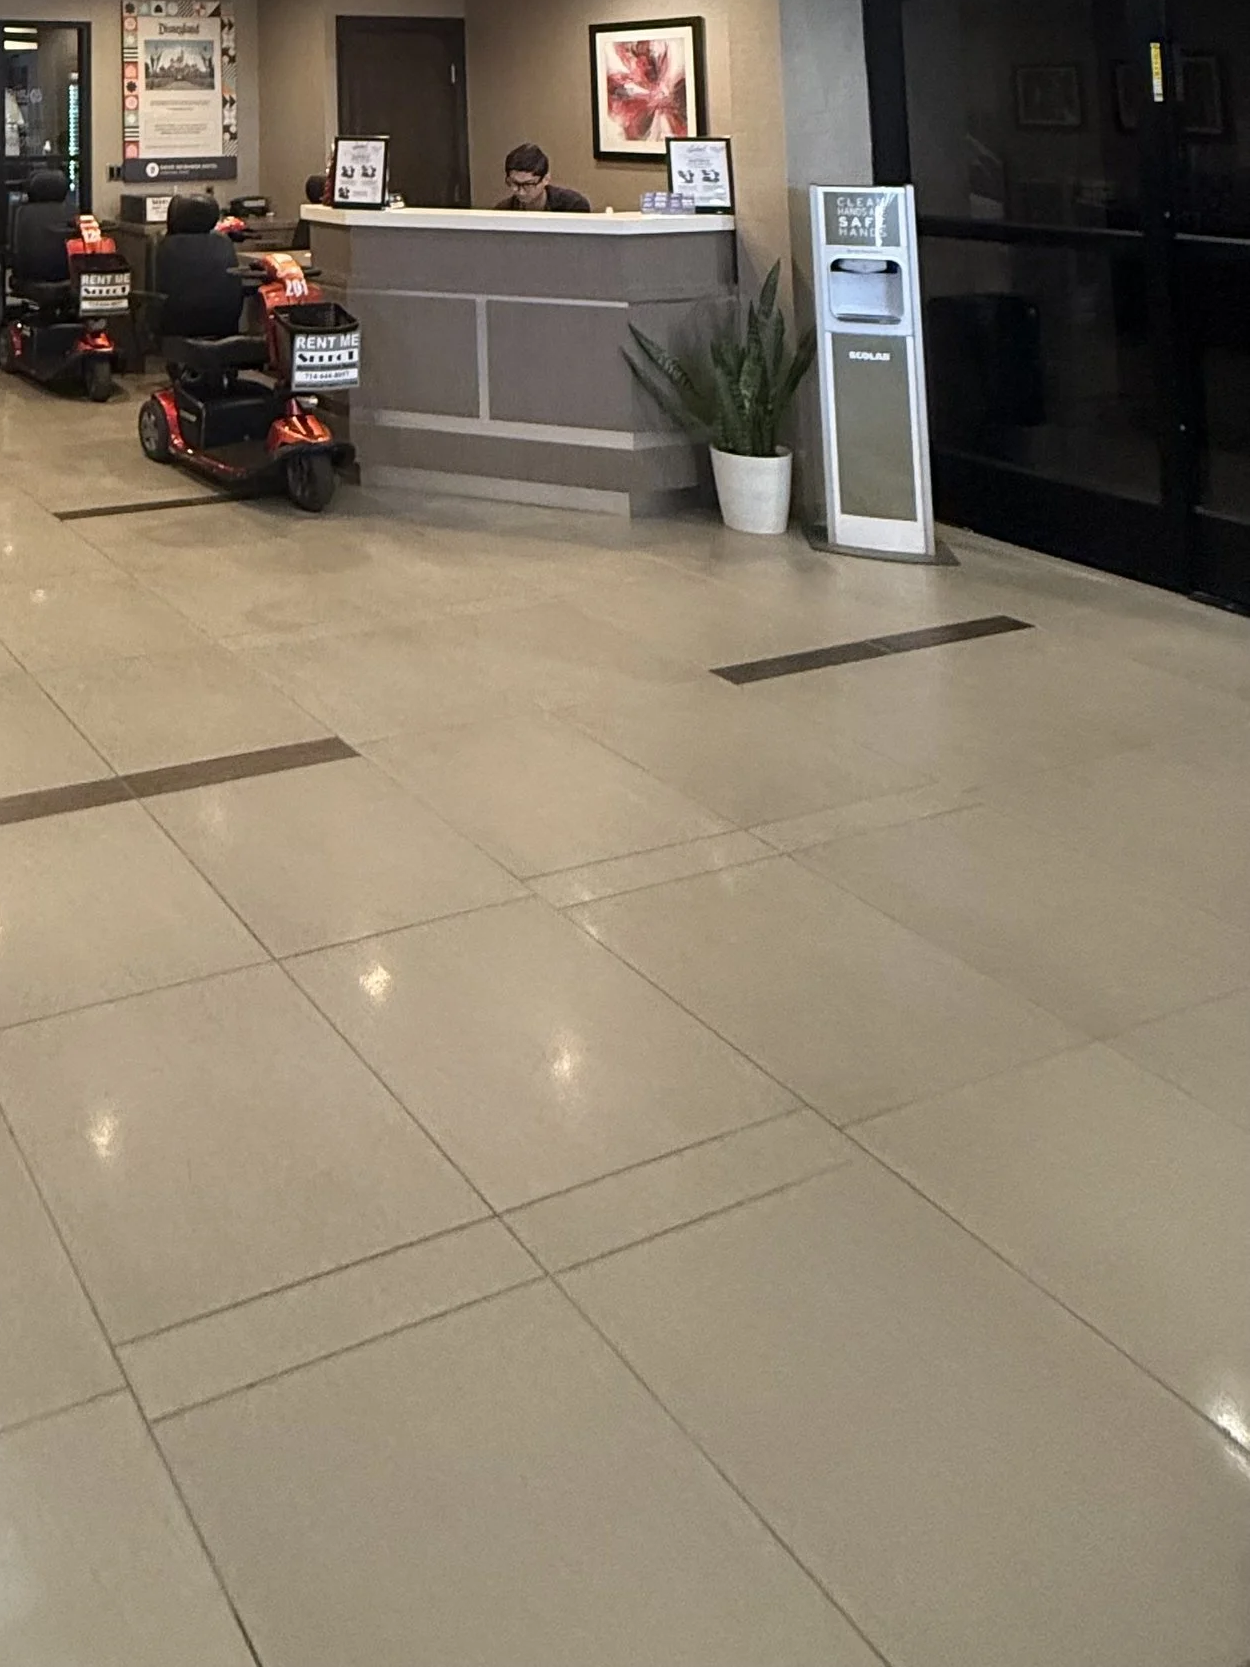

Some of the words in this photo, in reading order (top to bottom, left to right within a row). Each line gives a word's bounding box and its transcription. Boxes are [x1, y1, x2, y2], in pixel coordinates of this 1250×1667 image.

[82, 274, 112, 285] RENT
[115, 273, 130, 284] ME
[285, 278, 309, 297] 201
[296, 335, 336, 350] RENT
[340, 334, 359, 348] ME
